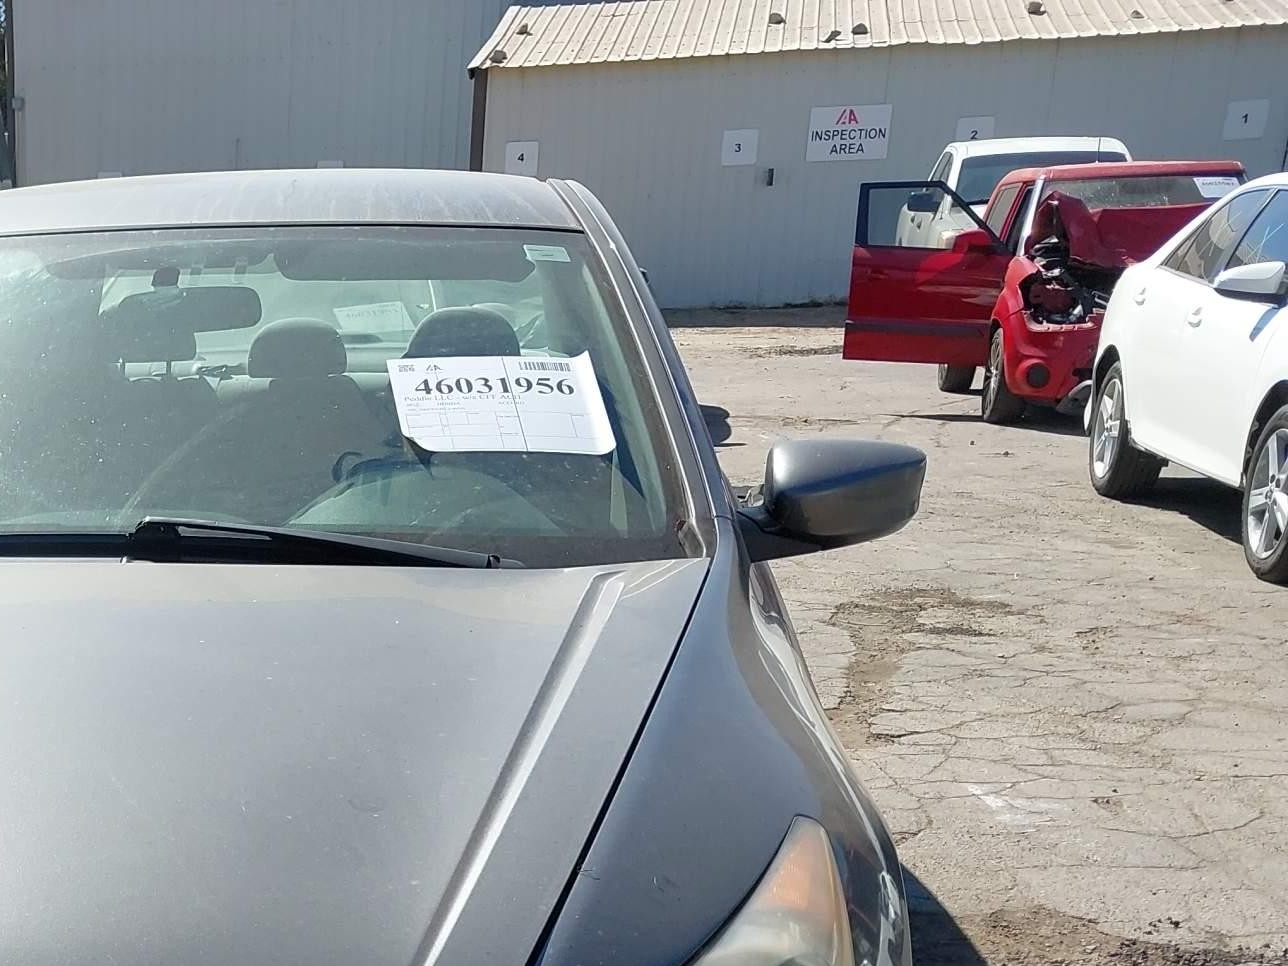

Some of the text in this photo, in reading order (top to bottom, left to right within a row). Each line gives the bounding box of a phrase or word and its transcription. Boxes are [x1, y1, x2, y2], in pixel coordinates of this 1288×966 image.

[1242, 113, 1249, 124] 1
[811, 127, 887, 142] INSPECTION
[970, 130, 979, 140] 2
[734, 143, 742, 153] 3
[829, 142, 865, 155] AREA
[517, 152, 525, 163] 4
[415, 376, 575, 396] 46031956
